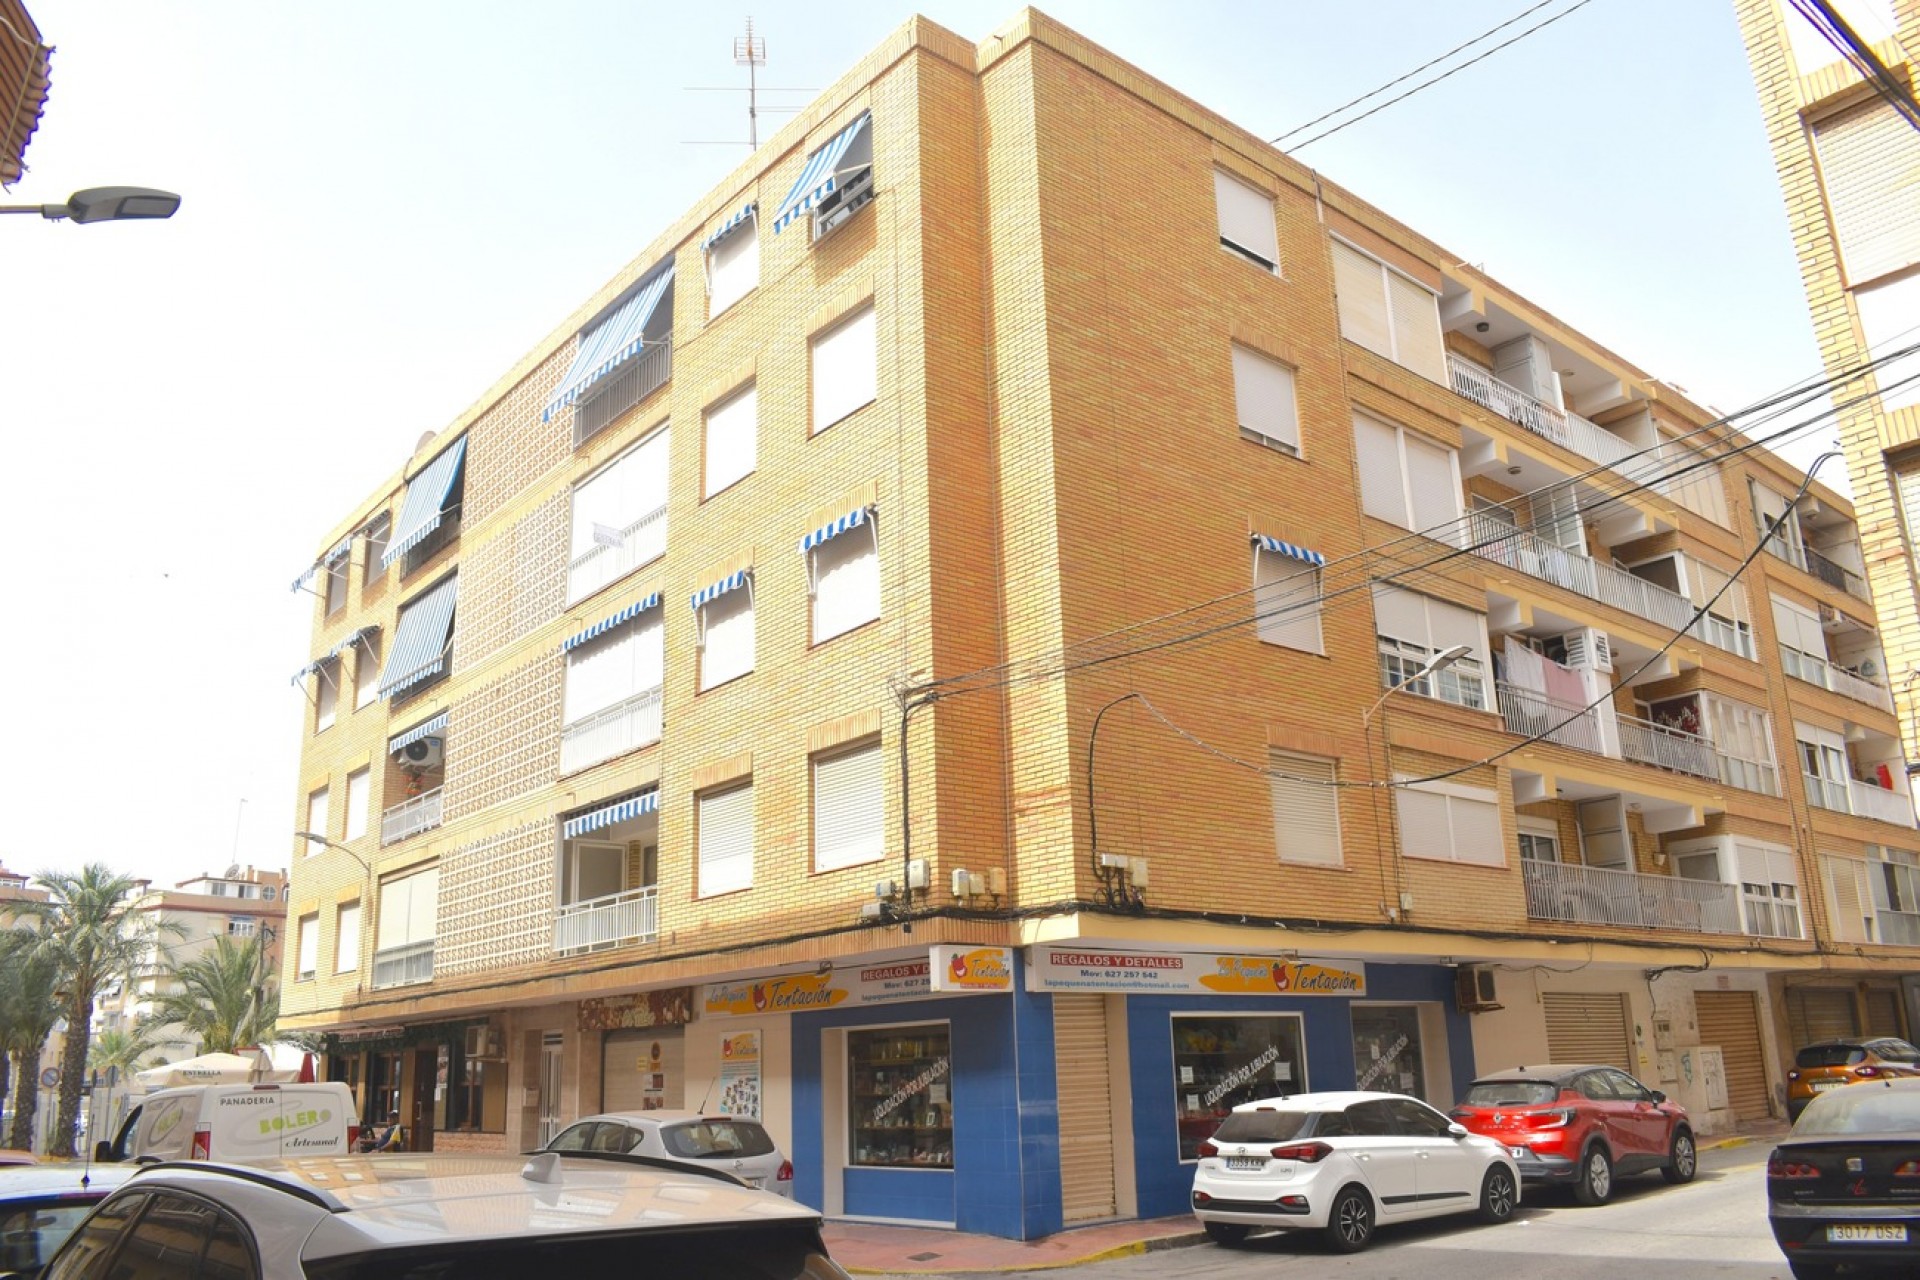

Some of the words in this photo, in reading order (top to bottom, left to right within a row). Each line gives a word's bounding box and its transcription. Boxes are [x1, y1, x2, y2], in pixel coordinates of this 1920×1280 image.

[1052, 954, 1111, 967] REGALOS
[1114, 956, 1122, 966] Y
[1125, 957, 1182, 969] DETALLES
[863, 965, 909, 981] REGALOS
[913, 963, 920, 976] Y
[1104, 970, 1121, 978] 627
[1293, 963, 1358, 991] Tentación
[769, 981, 833, 1008] Tentación
[182, 1069, 222, 1077] ESTRELLA
[219, 1096, 275, 1107] PANADERIA
[258, 1108, 332, 1135] BOLERO
[285, 1136, 339, 1148] Artesanal
[1836, 1226, 1870, 1240] 3017
